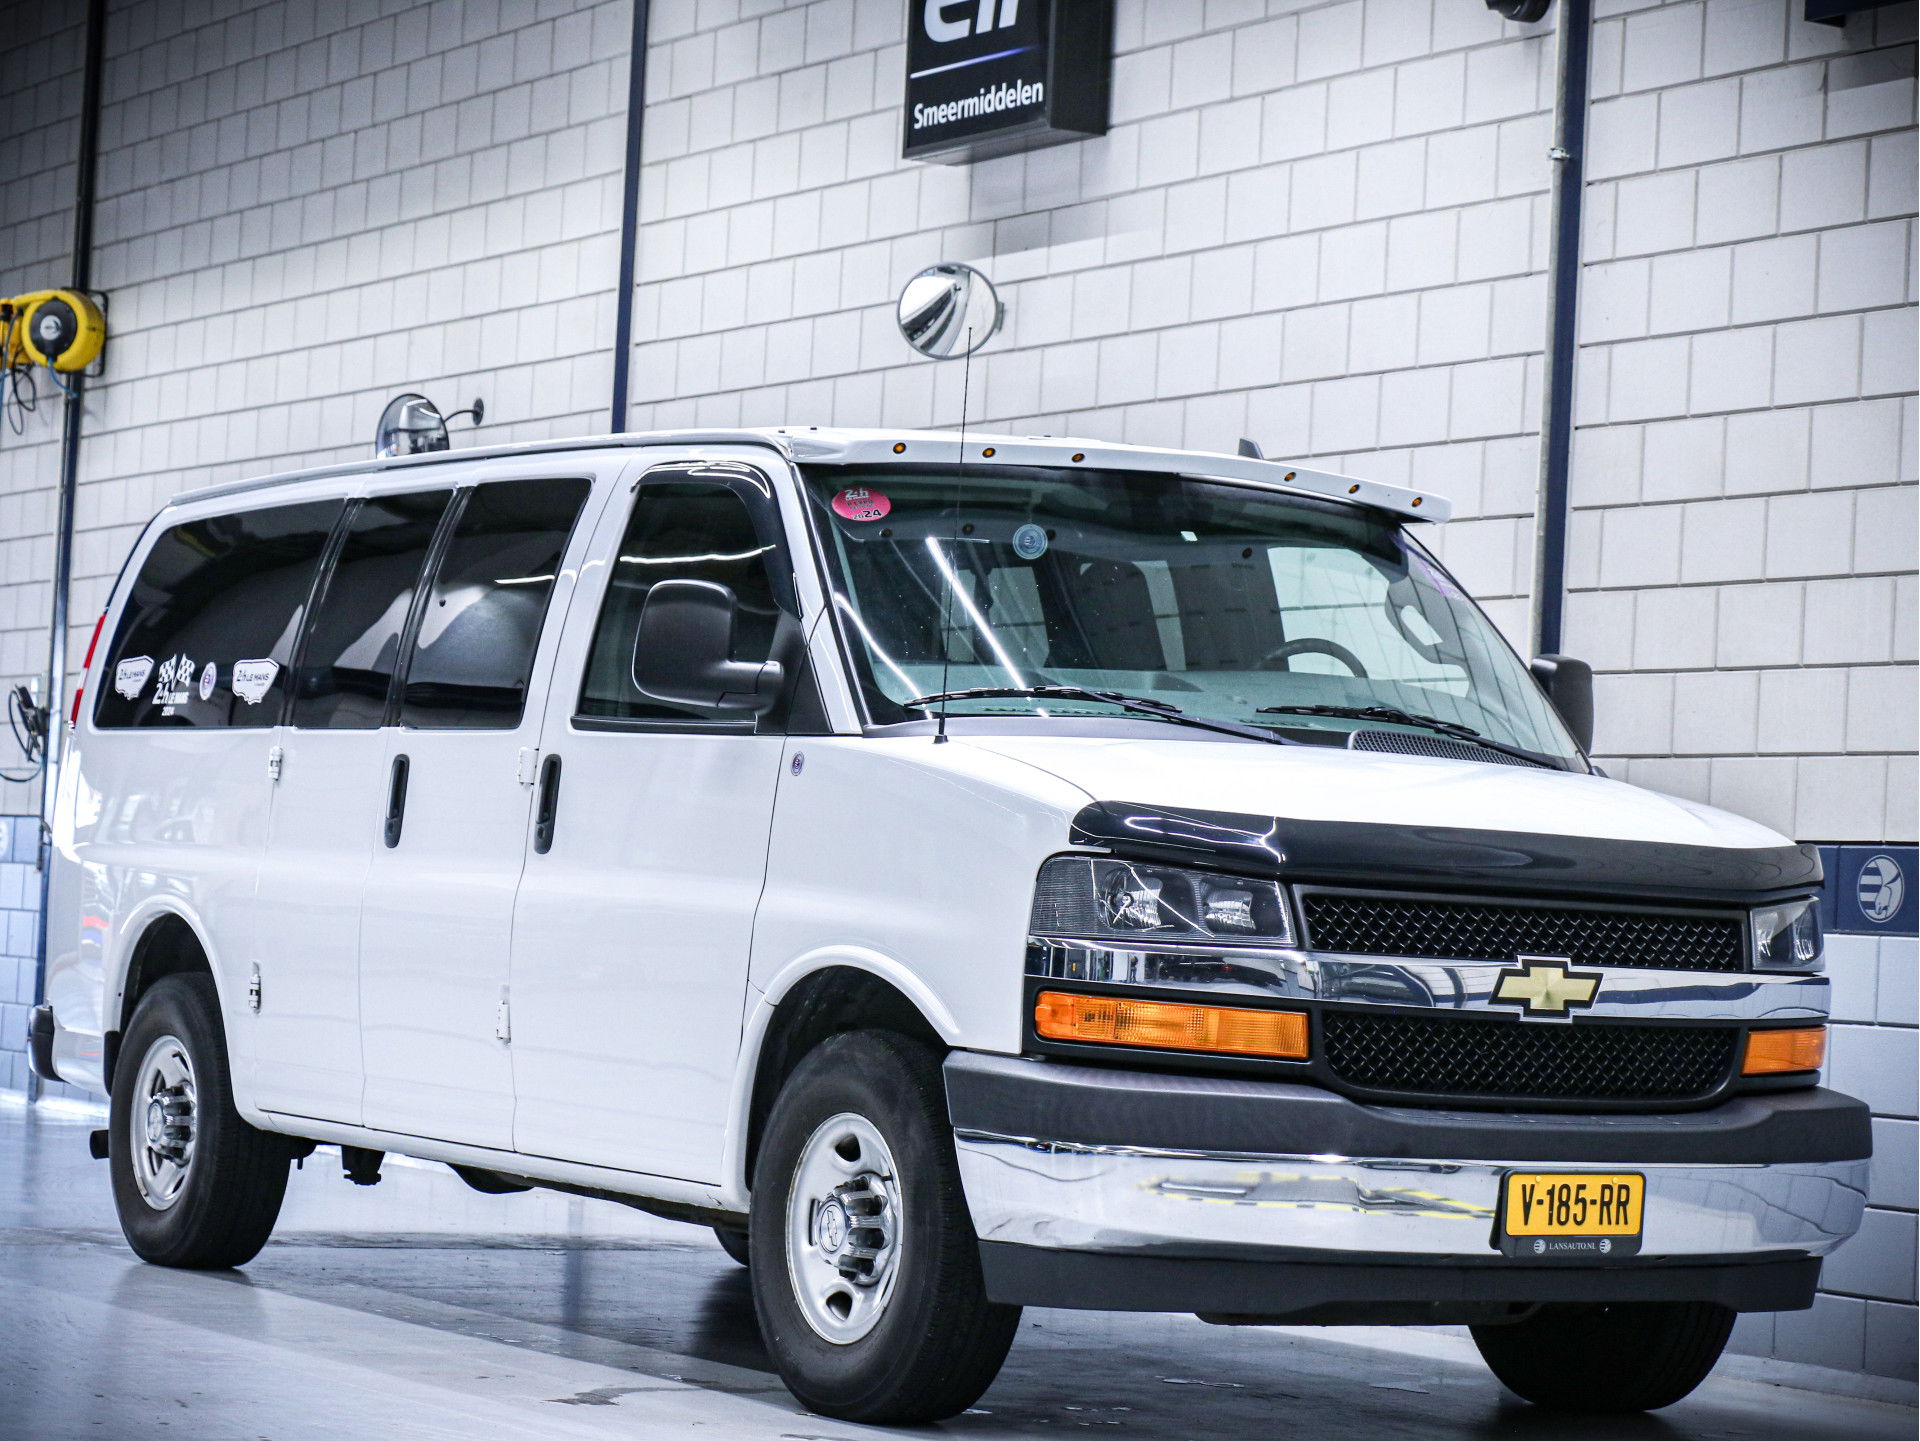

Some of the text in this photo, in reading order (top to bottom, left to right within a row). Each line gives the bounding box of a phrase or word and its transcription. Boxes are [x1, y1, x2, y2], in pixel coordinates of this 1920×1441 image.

[913, 79, 1044, 129] Smeermiddelen
[1522, 1183, 1630, 1226] V-185-RR
[1549, 1242, 1596, 1250] LANSAUTO.NL
